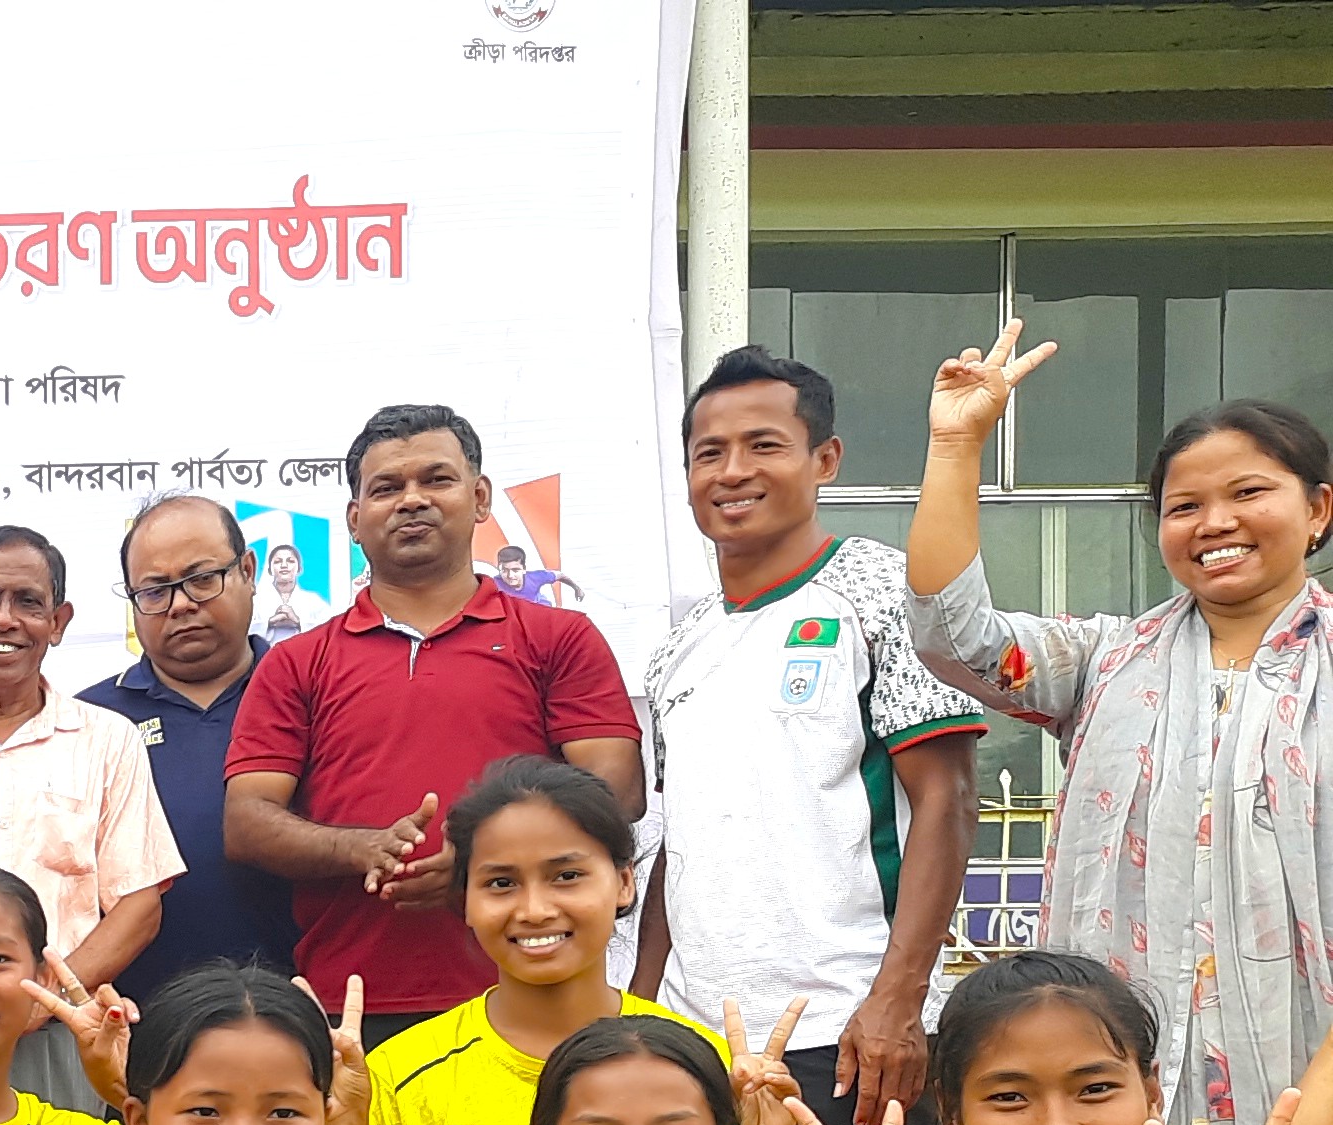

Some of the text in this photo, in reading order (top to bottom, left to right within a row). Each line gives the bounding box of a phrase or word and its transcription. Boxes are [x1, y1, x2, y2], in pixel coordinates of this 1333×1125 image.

[132, 175, 407, 317] অনুষ্ঠান
[25, 365, 125, 404] পরিষদ
[22, 460, 160, 493] বান্দরবান
[171, 448, 268, 490] পার্বত্য
